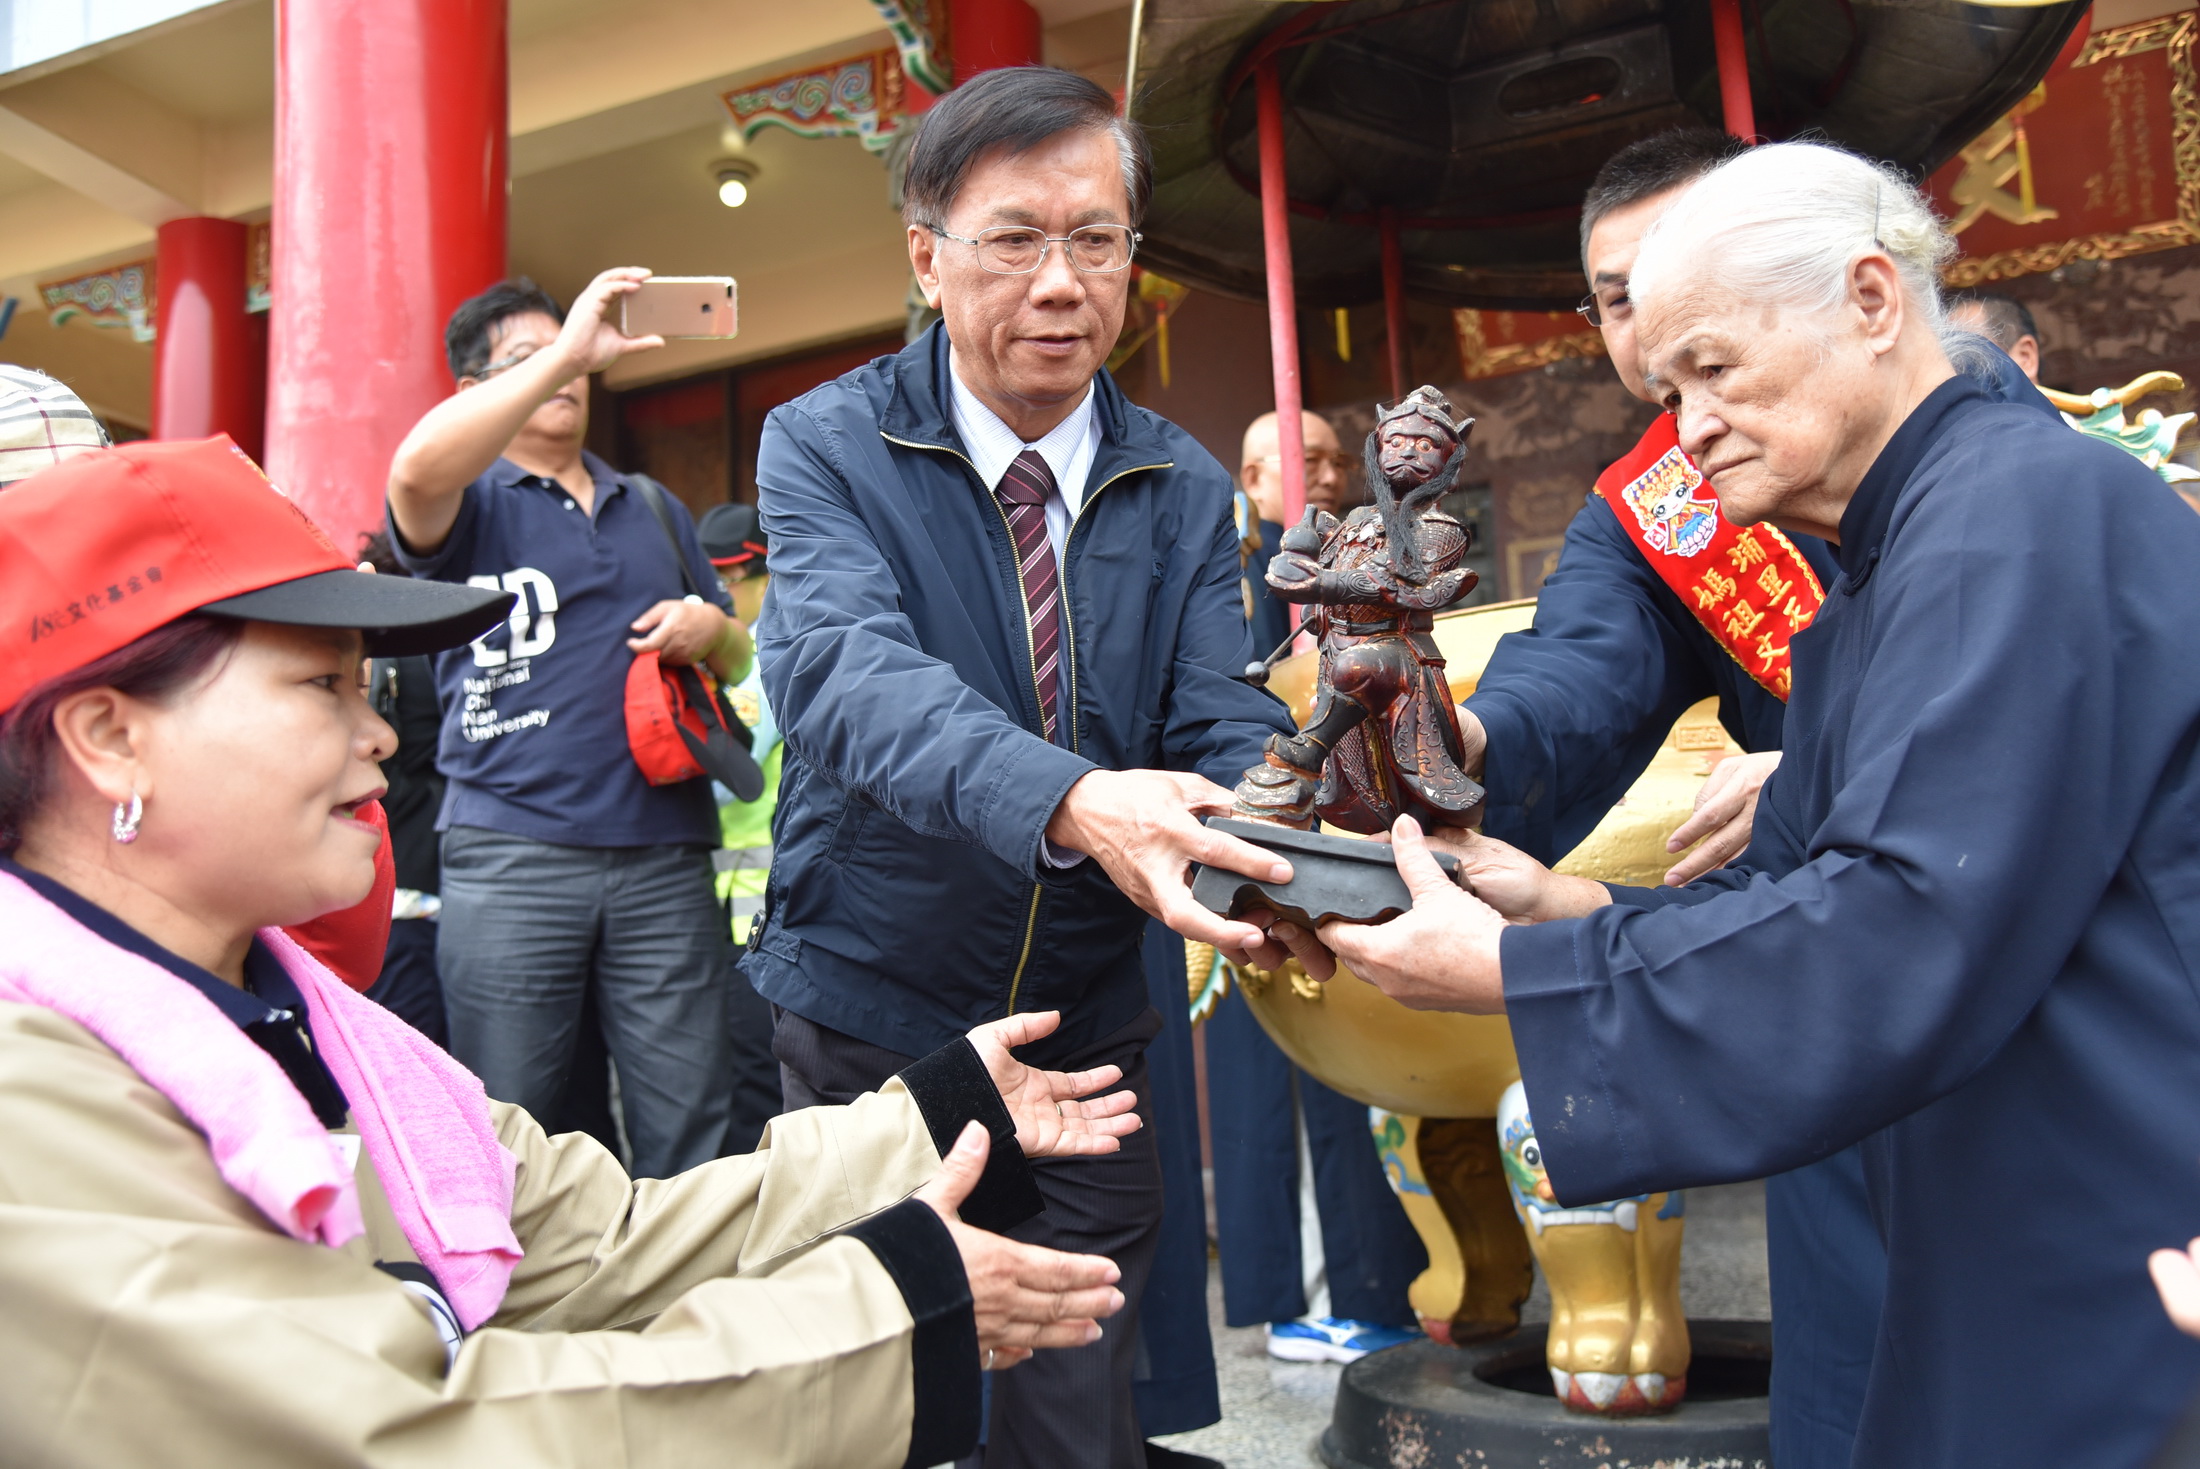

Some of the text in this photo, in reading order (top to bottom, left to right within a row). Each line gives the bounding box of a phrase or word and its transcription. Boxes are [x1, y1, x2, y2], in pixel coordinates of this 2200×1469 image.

[463, 667, 531, 695] National
[464, 693, 492, 711] Chi
[461, 709, 498, 728] Nan
[462, 709, 551, 743] University
